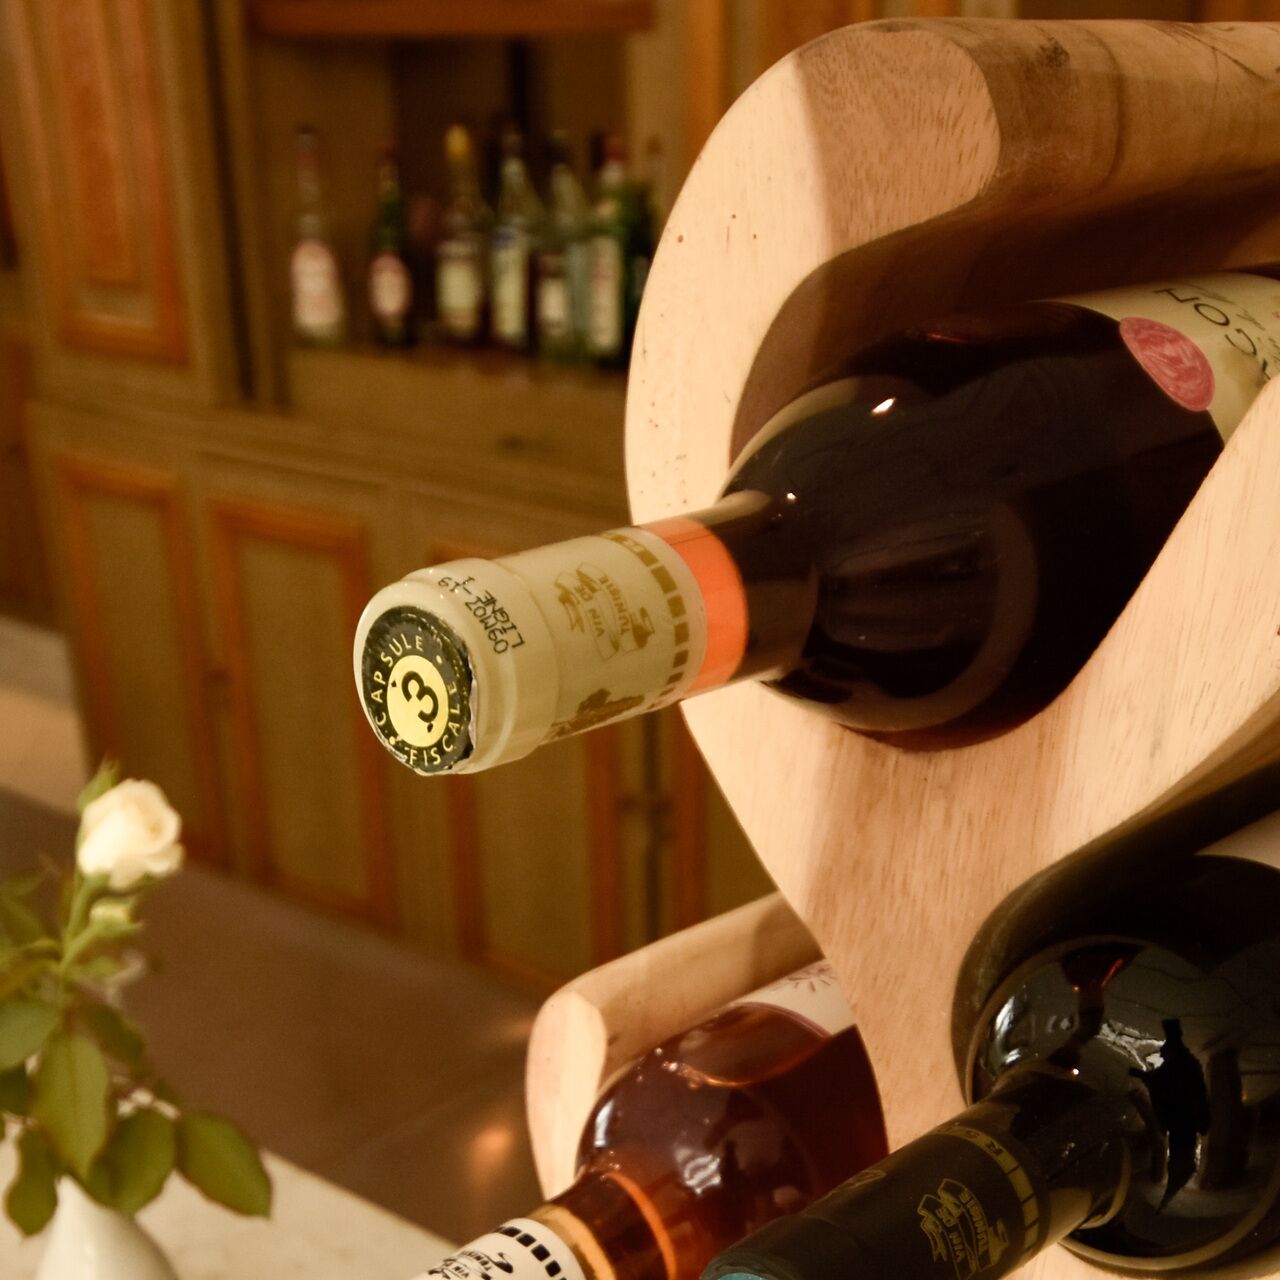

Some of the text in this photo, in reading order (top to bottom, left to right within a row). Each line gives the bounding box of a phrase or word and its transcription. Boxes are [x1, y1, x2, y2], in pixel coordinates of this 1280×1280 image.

[483, 590, 526, 649] LIGNE
[588, 607, 606, 638] VIN
[600, 575, 630, 635] TUNISIE
[371, 632, 462, 767] CAPSULE FISCALE
[401, 670, 439, 723] 3
